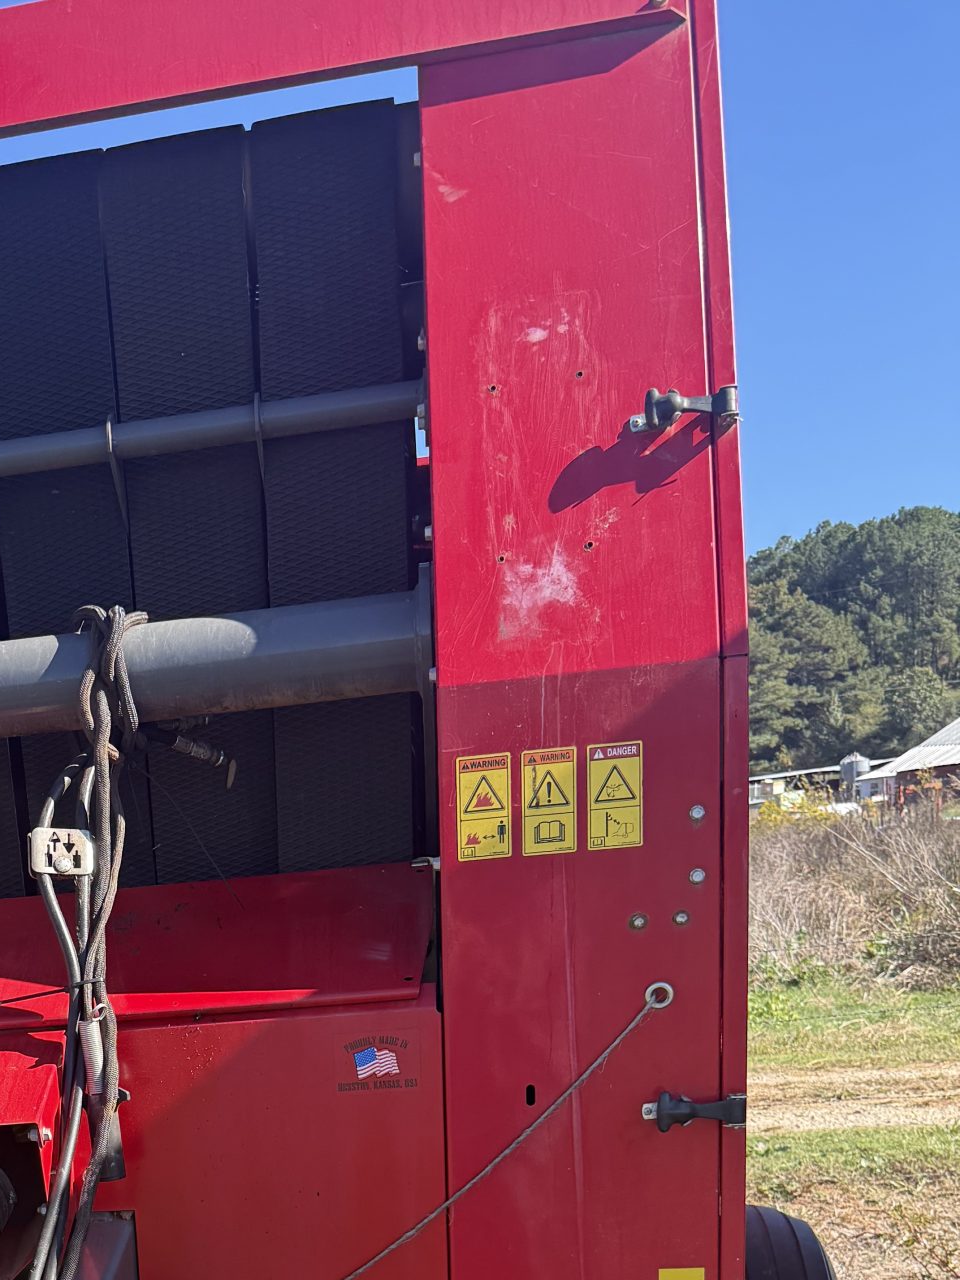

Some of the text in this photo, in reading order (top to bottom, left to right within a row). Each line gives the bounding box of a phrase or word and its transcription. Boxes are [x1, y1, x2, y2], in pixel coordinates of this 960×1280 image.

[607, 746, 637, 756] DANGER
[539, 752, 571, 762] WARNING
[470, 759, 506, 769] WARNING
[379, 1035, 399, 1046] MADE
